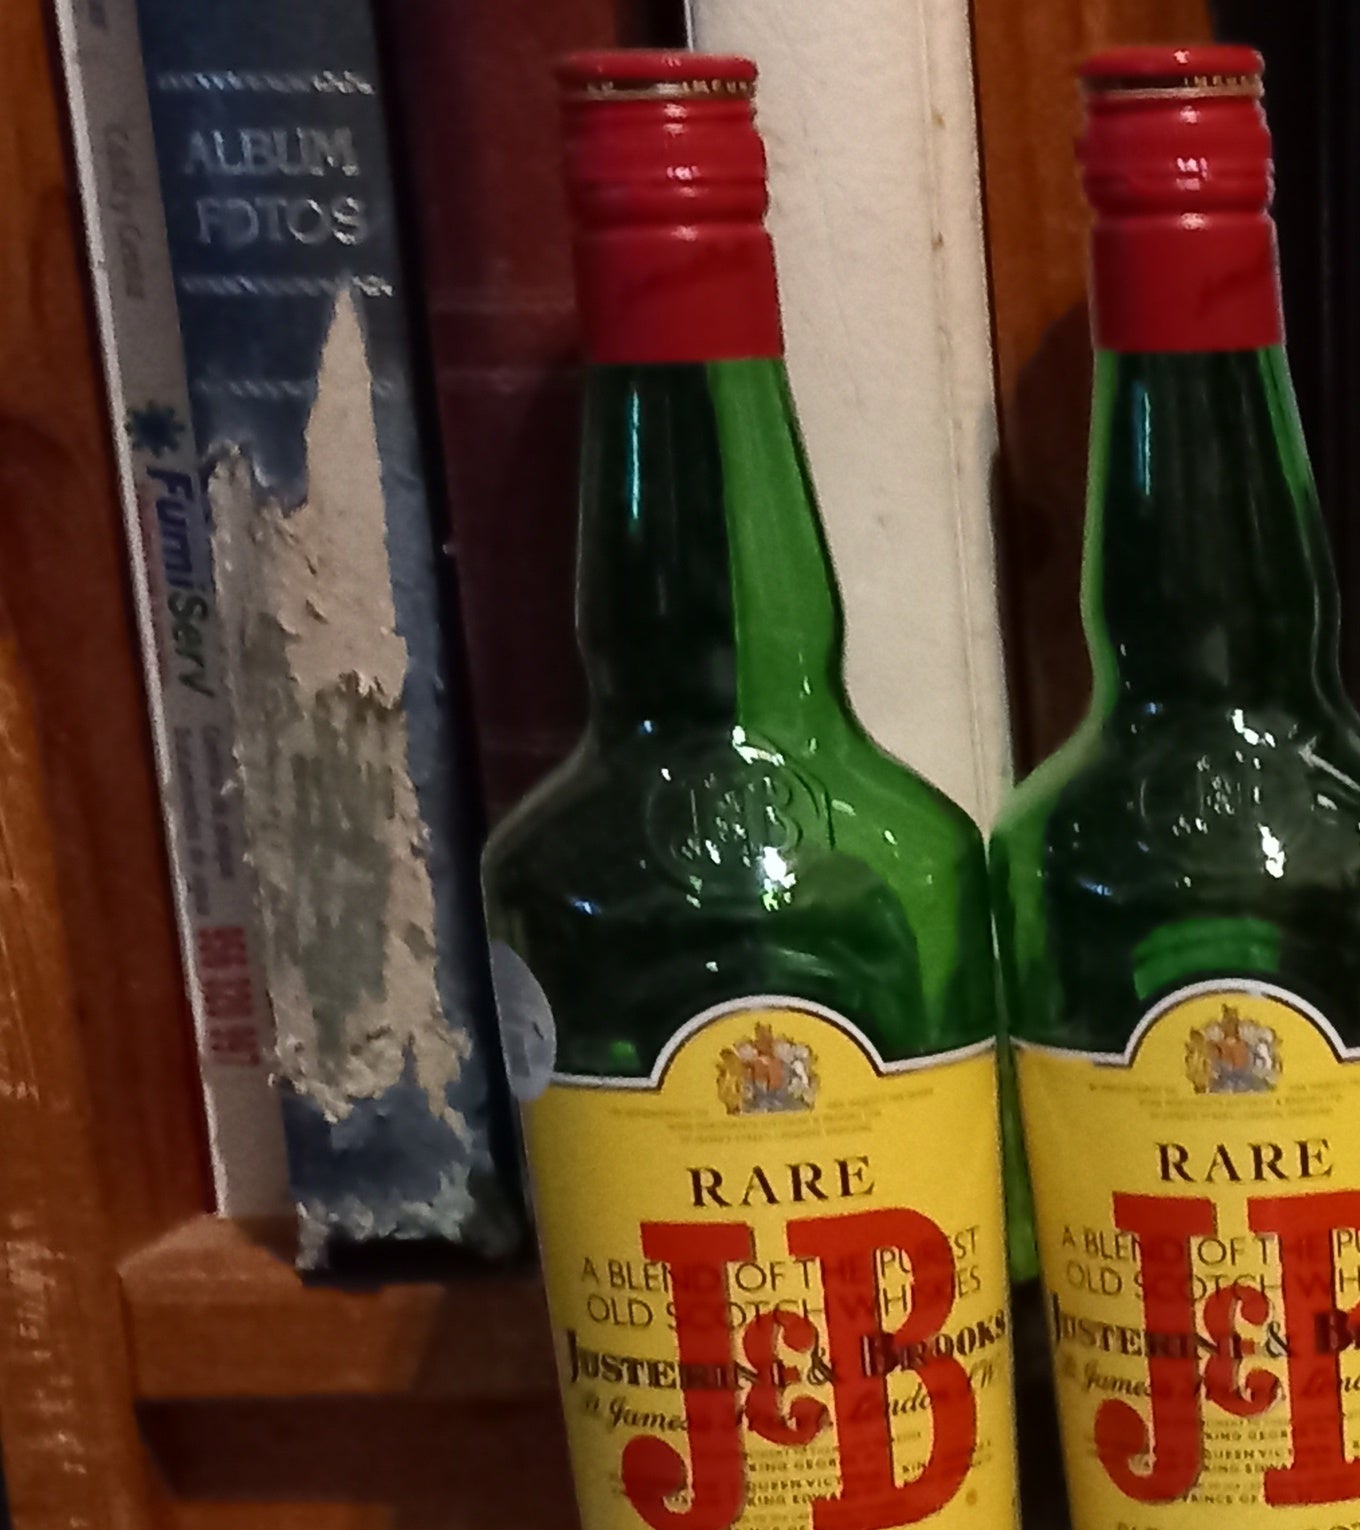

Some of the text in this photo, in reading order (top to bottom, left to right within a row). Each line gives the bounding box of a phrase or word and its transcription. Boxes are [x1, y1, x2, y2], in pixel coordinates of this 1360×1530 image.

[185, 127, 359, 176] ALBUM
[197, 196, 366, 245] FOTOS
[1154, 1137, 1334, 1184] RARE
[686, 1155, 876, 1208] RARE
[1197, 1237, 1247, 1267] OF
[582, 1256, 600, 1283] A
[734, 1260, 786, 1293] OF
[1066, 1260, 1123, 1296] OLD
[586, 1294, 654, 1327] OLD
[1263, 1320, 1290, 1359] &
